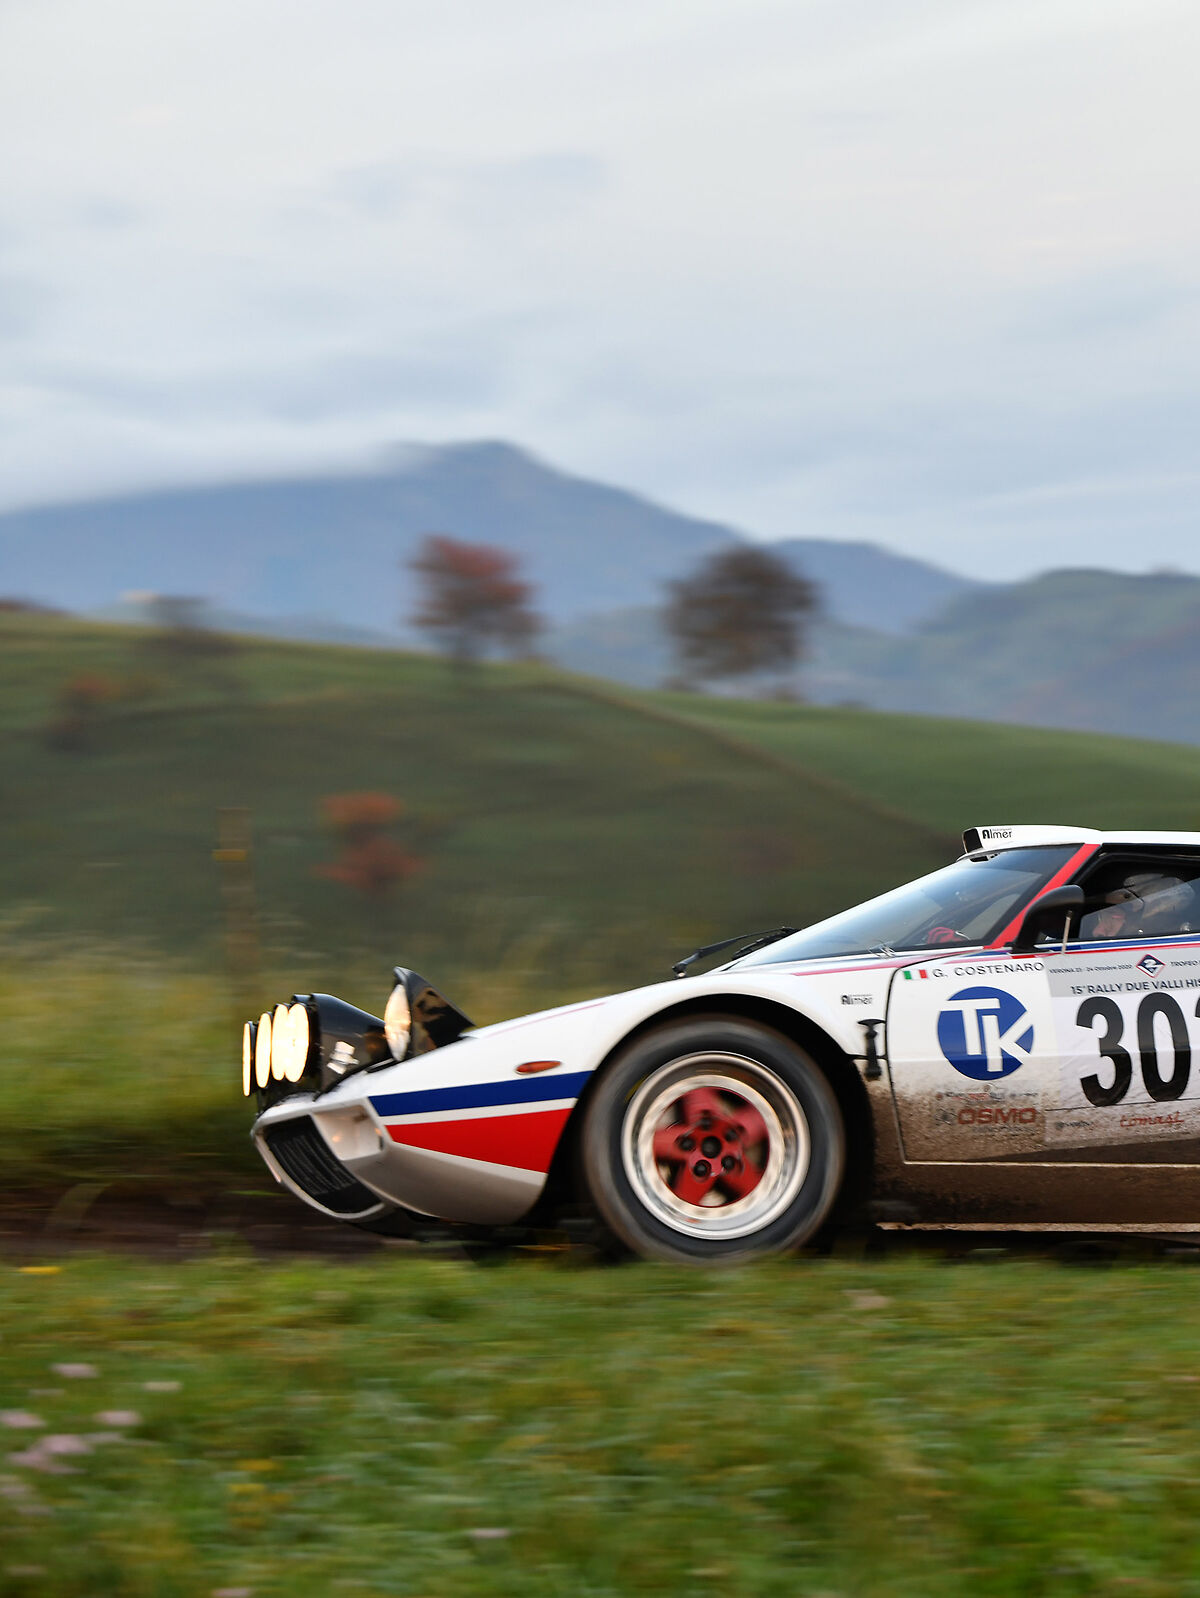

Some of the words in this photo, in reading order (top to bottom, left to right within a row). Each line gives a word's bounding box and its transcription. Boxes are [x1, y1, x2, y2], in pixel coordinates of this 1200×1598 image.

[982, 829, 1012, 839] Almer
[932, 968, 948, 978] G.
[954, 962, 1045, 977] COSTENARO
[1087, 983, 1123, 994] RALLY
[1126, 981, 1149, 991] DUE
[1151, 979, 1184, 990] VALLI
[938, 992, 1034, 1076] TK
[958, 1107, 1037, 1125] OSMO
